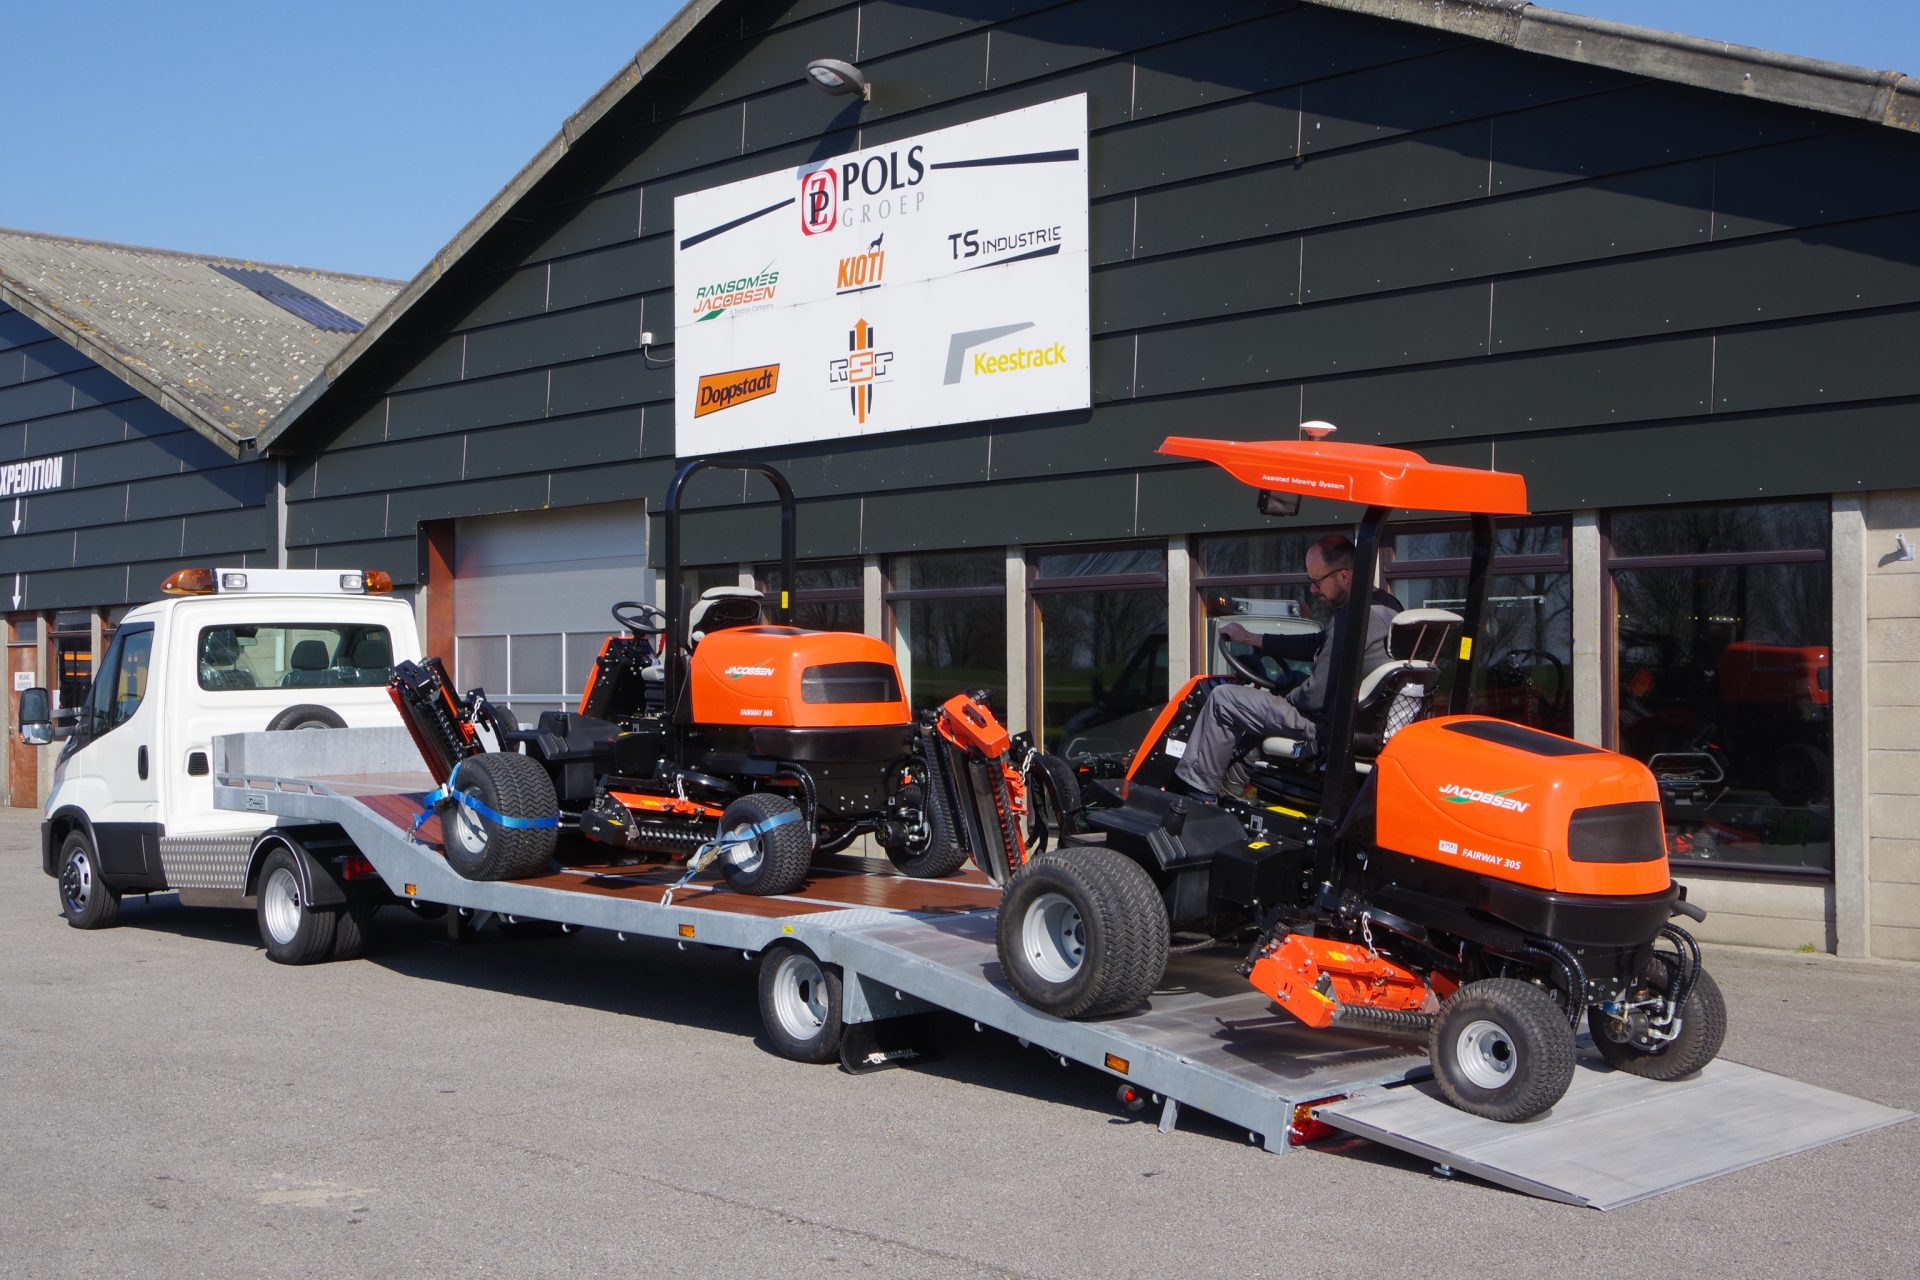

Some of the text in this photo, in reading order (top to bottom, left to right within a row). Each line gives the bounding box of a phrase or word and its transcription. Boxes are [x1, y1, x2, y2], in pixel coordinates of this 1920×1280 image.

[842, 145, 925, 202] POLS
[842, 191, 925, 228] GROEP
[948, 226, 1062, 260] TS INDUSTRIE
[696, 271, 779, 299] RANSOMES
[836, 250, 885, 289] KIOTI
[693, 286, 776, 314] JACOBSEN
[974, 342, 1067, 376] Keestrack
[700, 370, 773, 407] Doppstadt
[0, 456, 63, 496] XPEDITION
[1262, 474, 1345, 490] Assisted Mowing System
[724, 666, 776, 677] JACOBSEN
[1438, 784, 1529, 813] JACOBSEN
[1462, 848, 1522, 870] FAIRWAY 305
